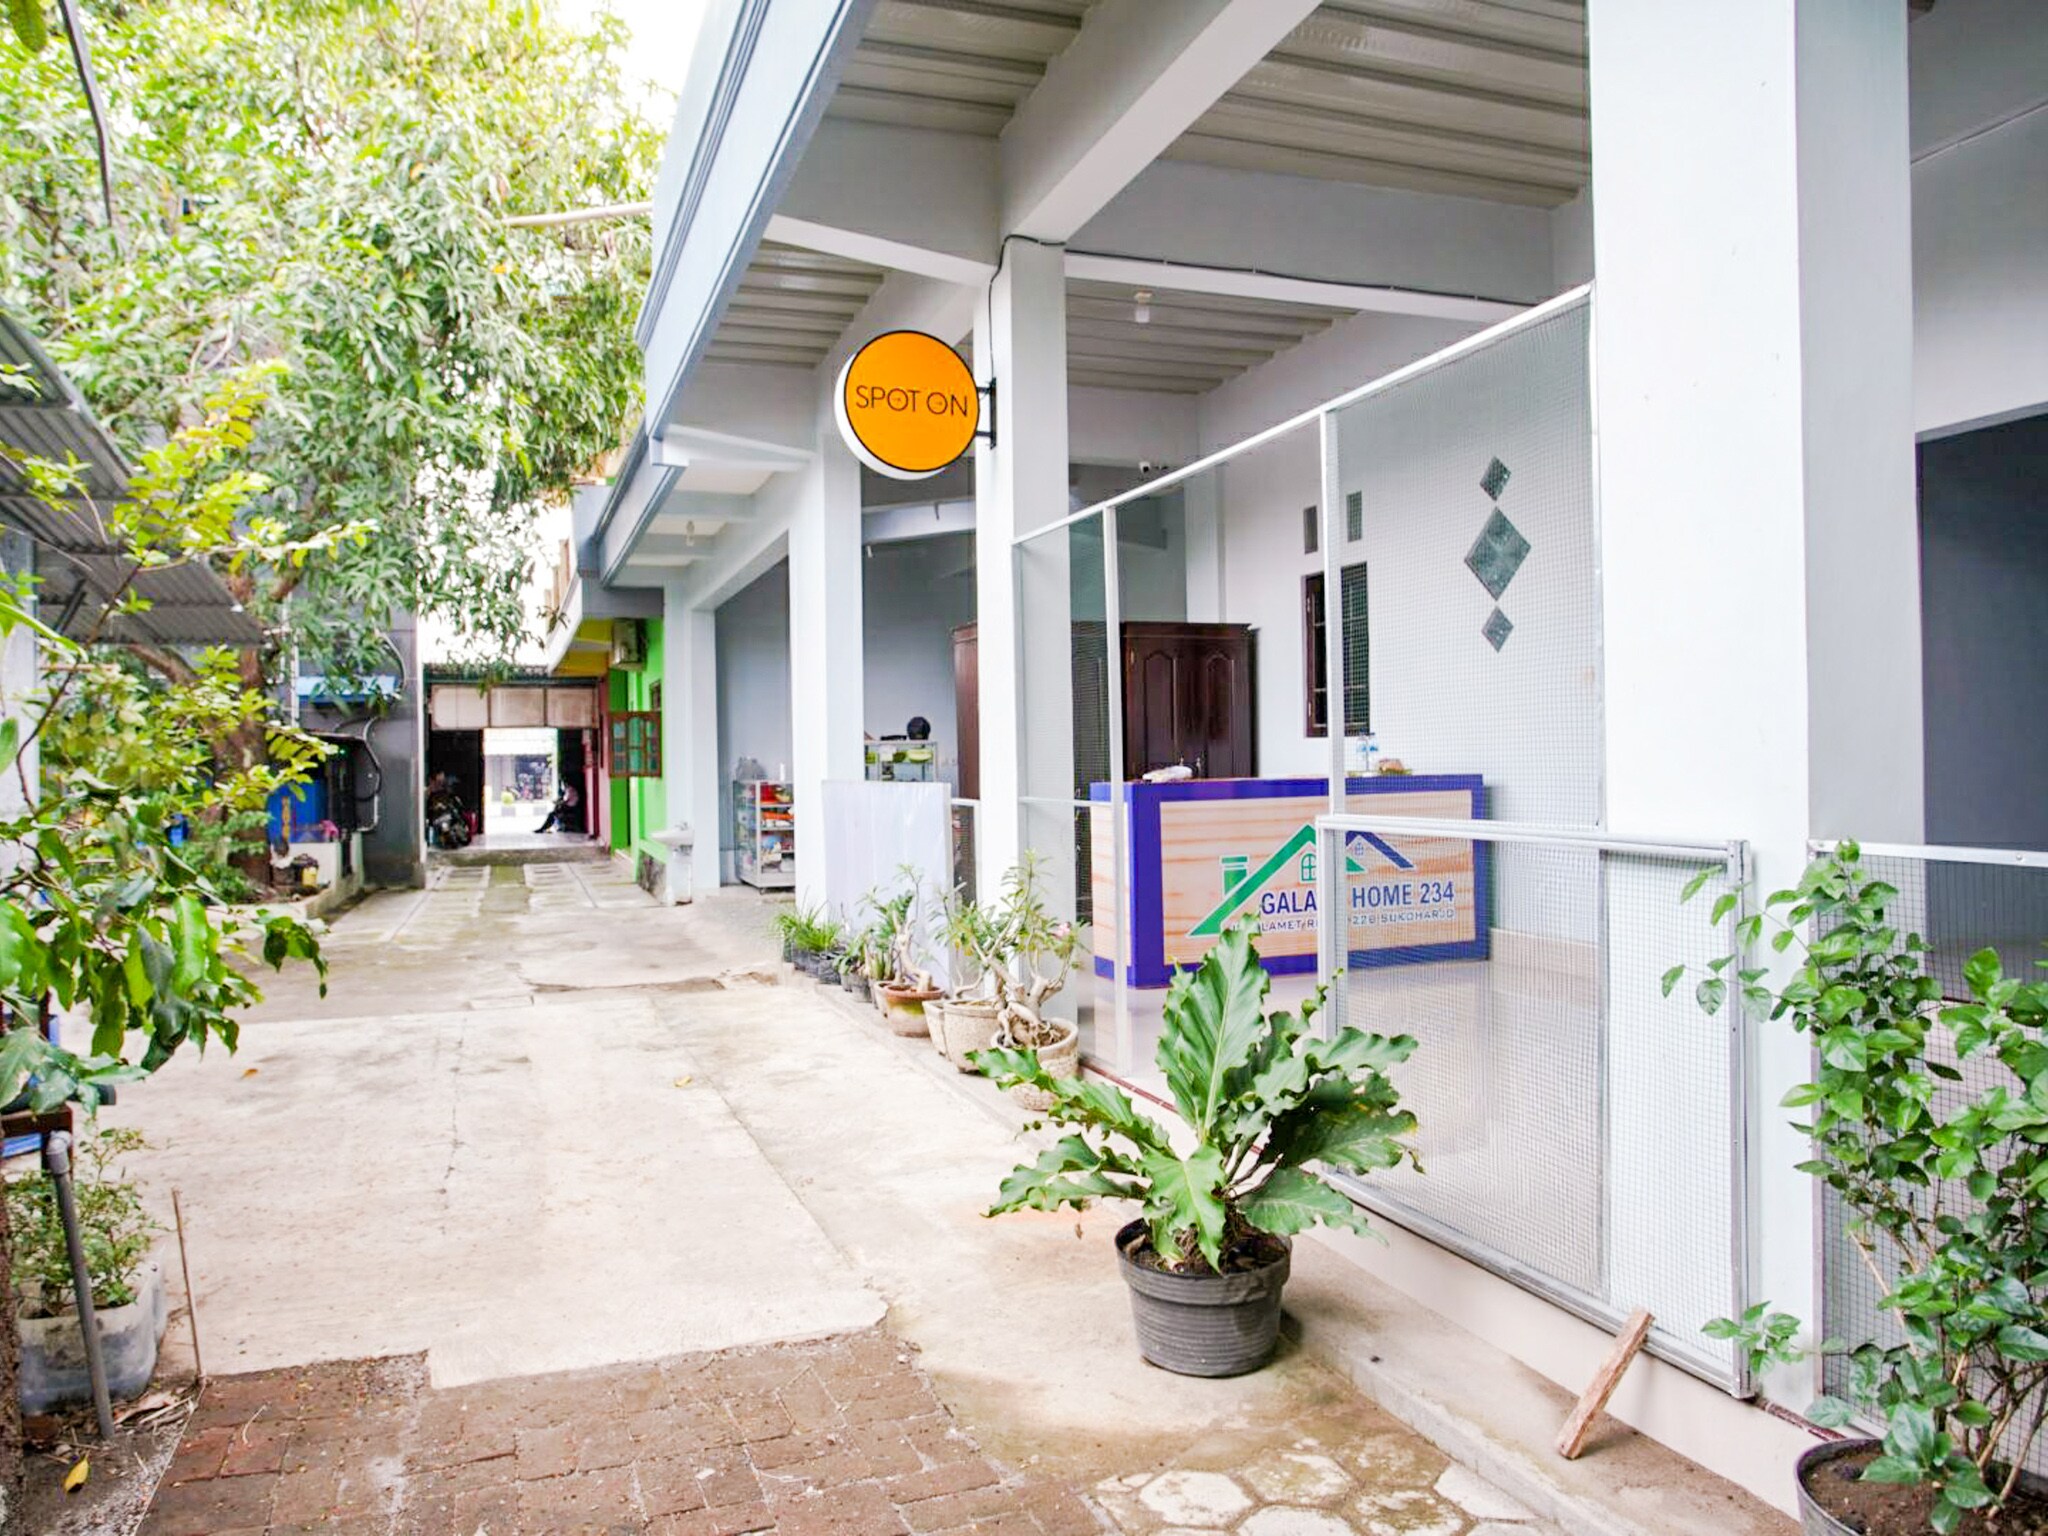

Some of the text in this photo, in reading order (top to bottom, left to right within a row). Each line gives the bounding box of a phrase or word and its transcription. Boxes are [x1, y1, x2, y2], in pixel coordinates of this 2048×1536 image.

[855, 384, 968, 417] SPOT ON
[1260, 880, 1455, 915] GALA HOME 234
[1258, 919, 1302, 932] LAMET
